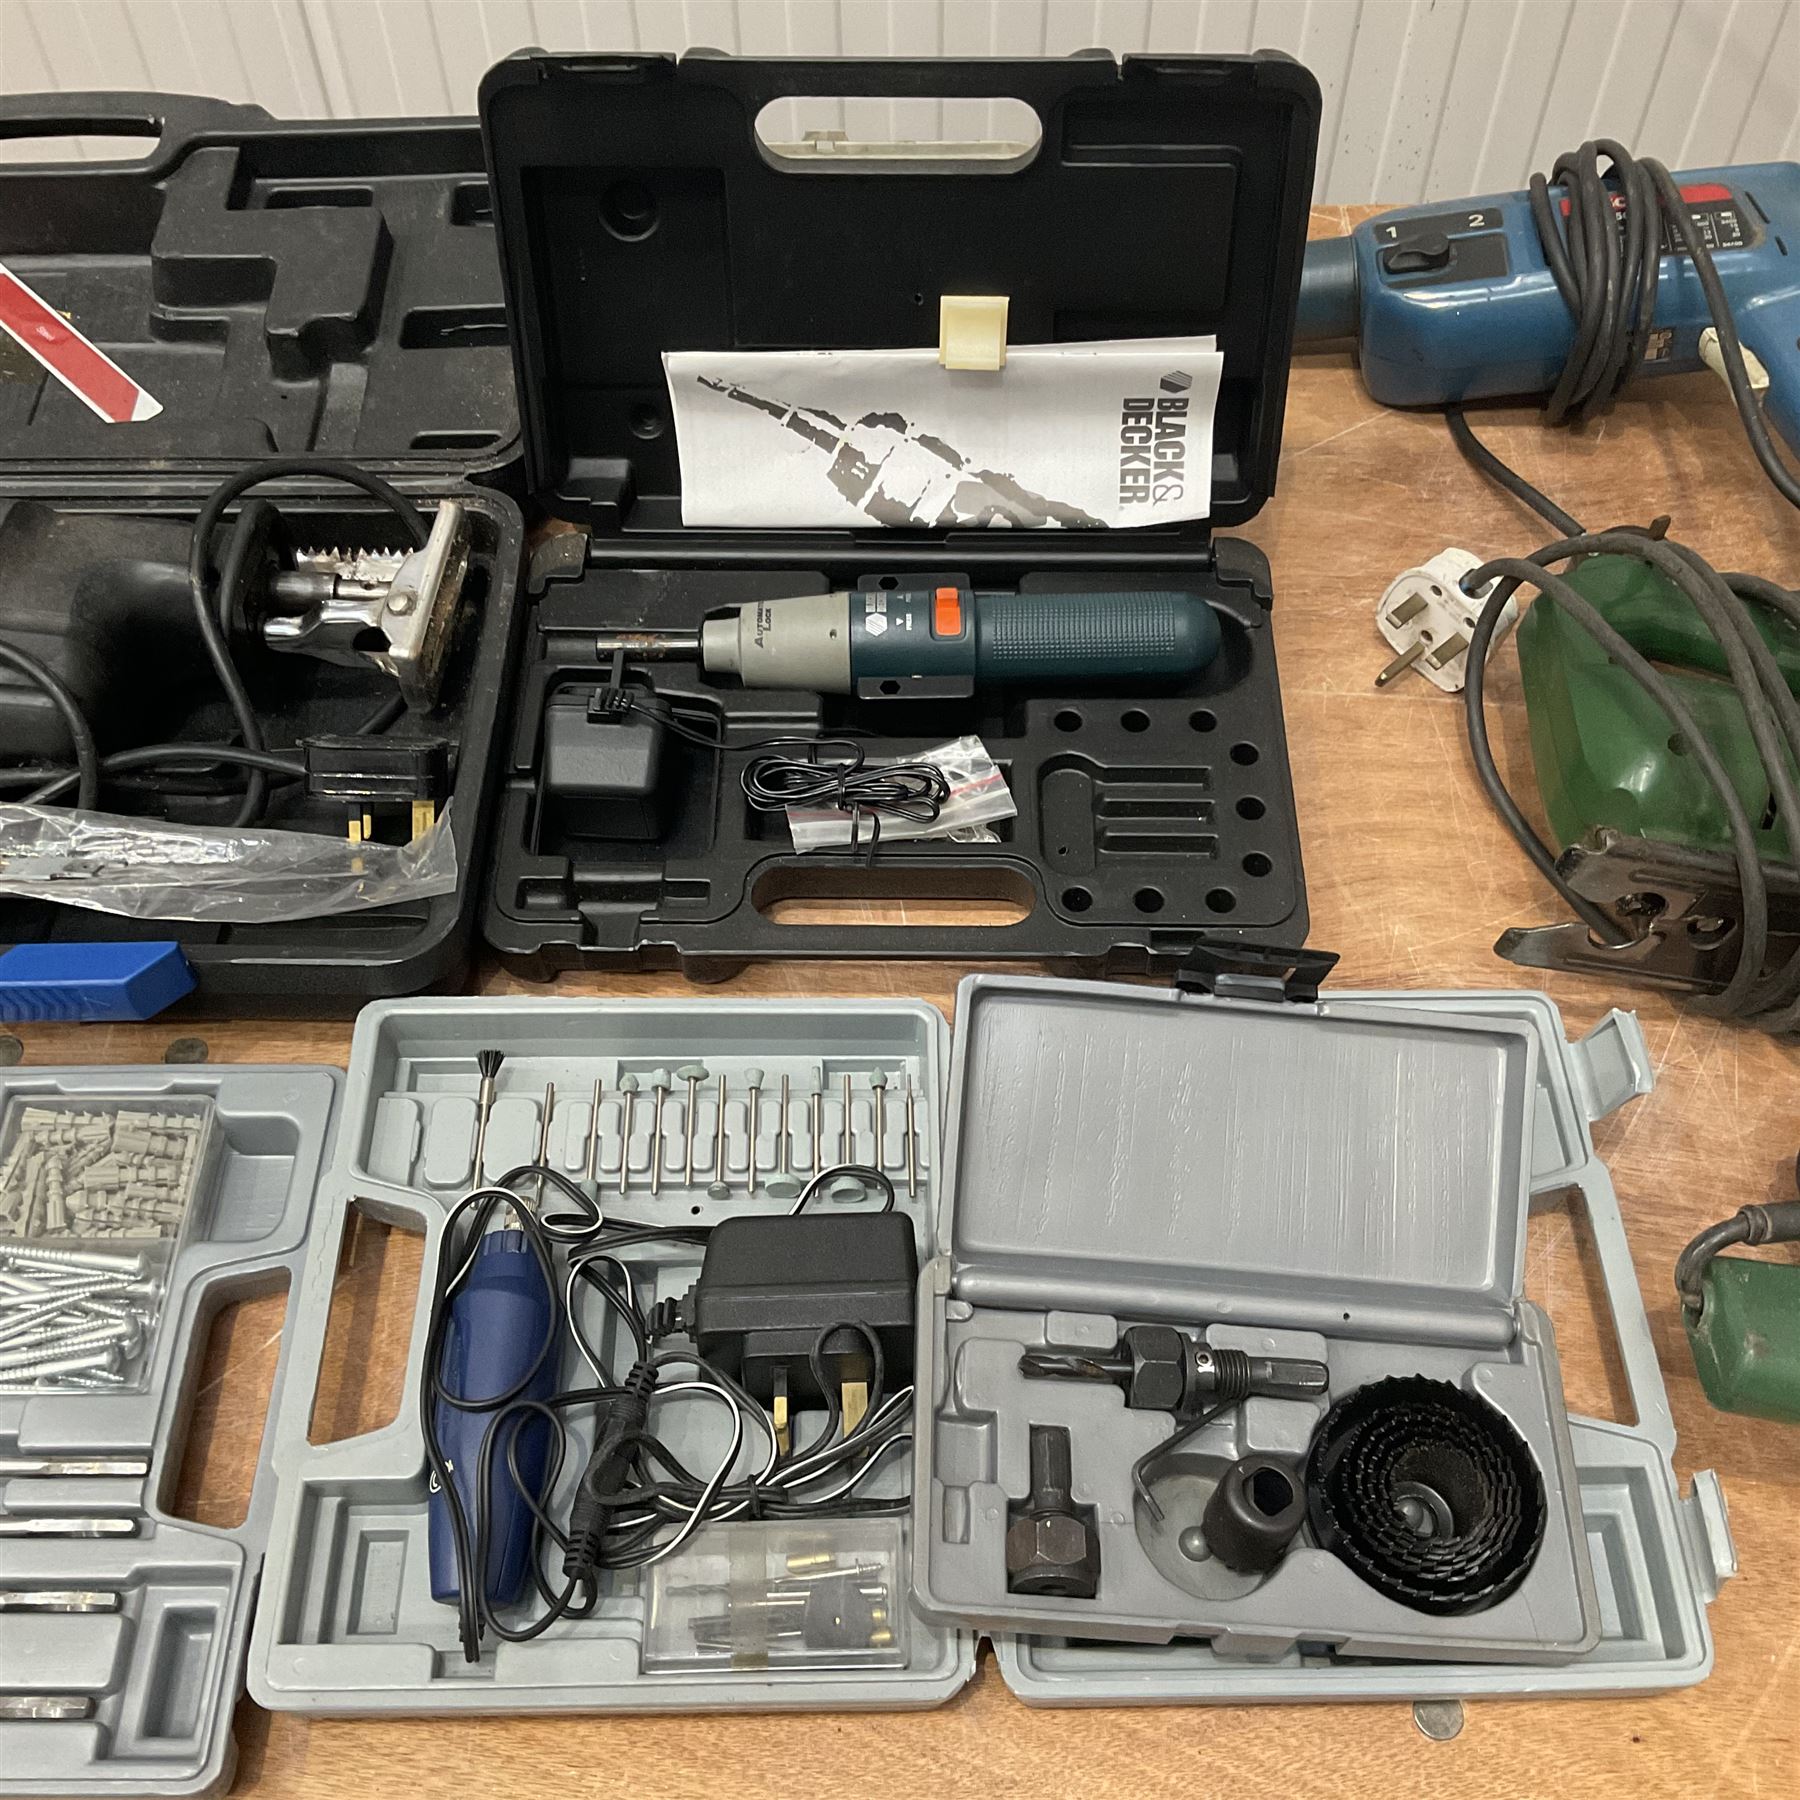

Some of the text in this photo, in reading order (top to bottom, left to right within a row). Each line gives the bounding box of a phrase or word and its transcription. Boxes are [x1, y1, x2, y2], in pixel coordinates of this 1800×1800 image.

[1468, 214, 1485, 227] 2
[1386, 226, 1397, 238] 1
[1119, 398, 1155, 504] DECKER
